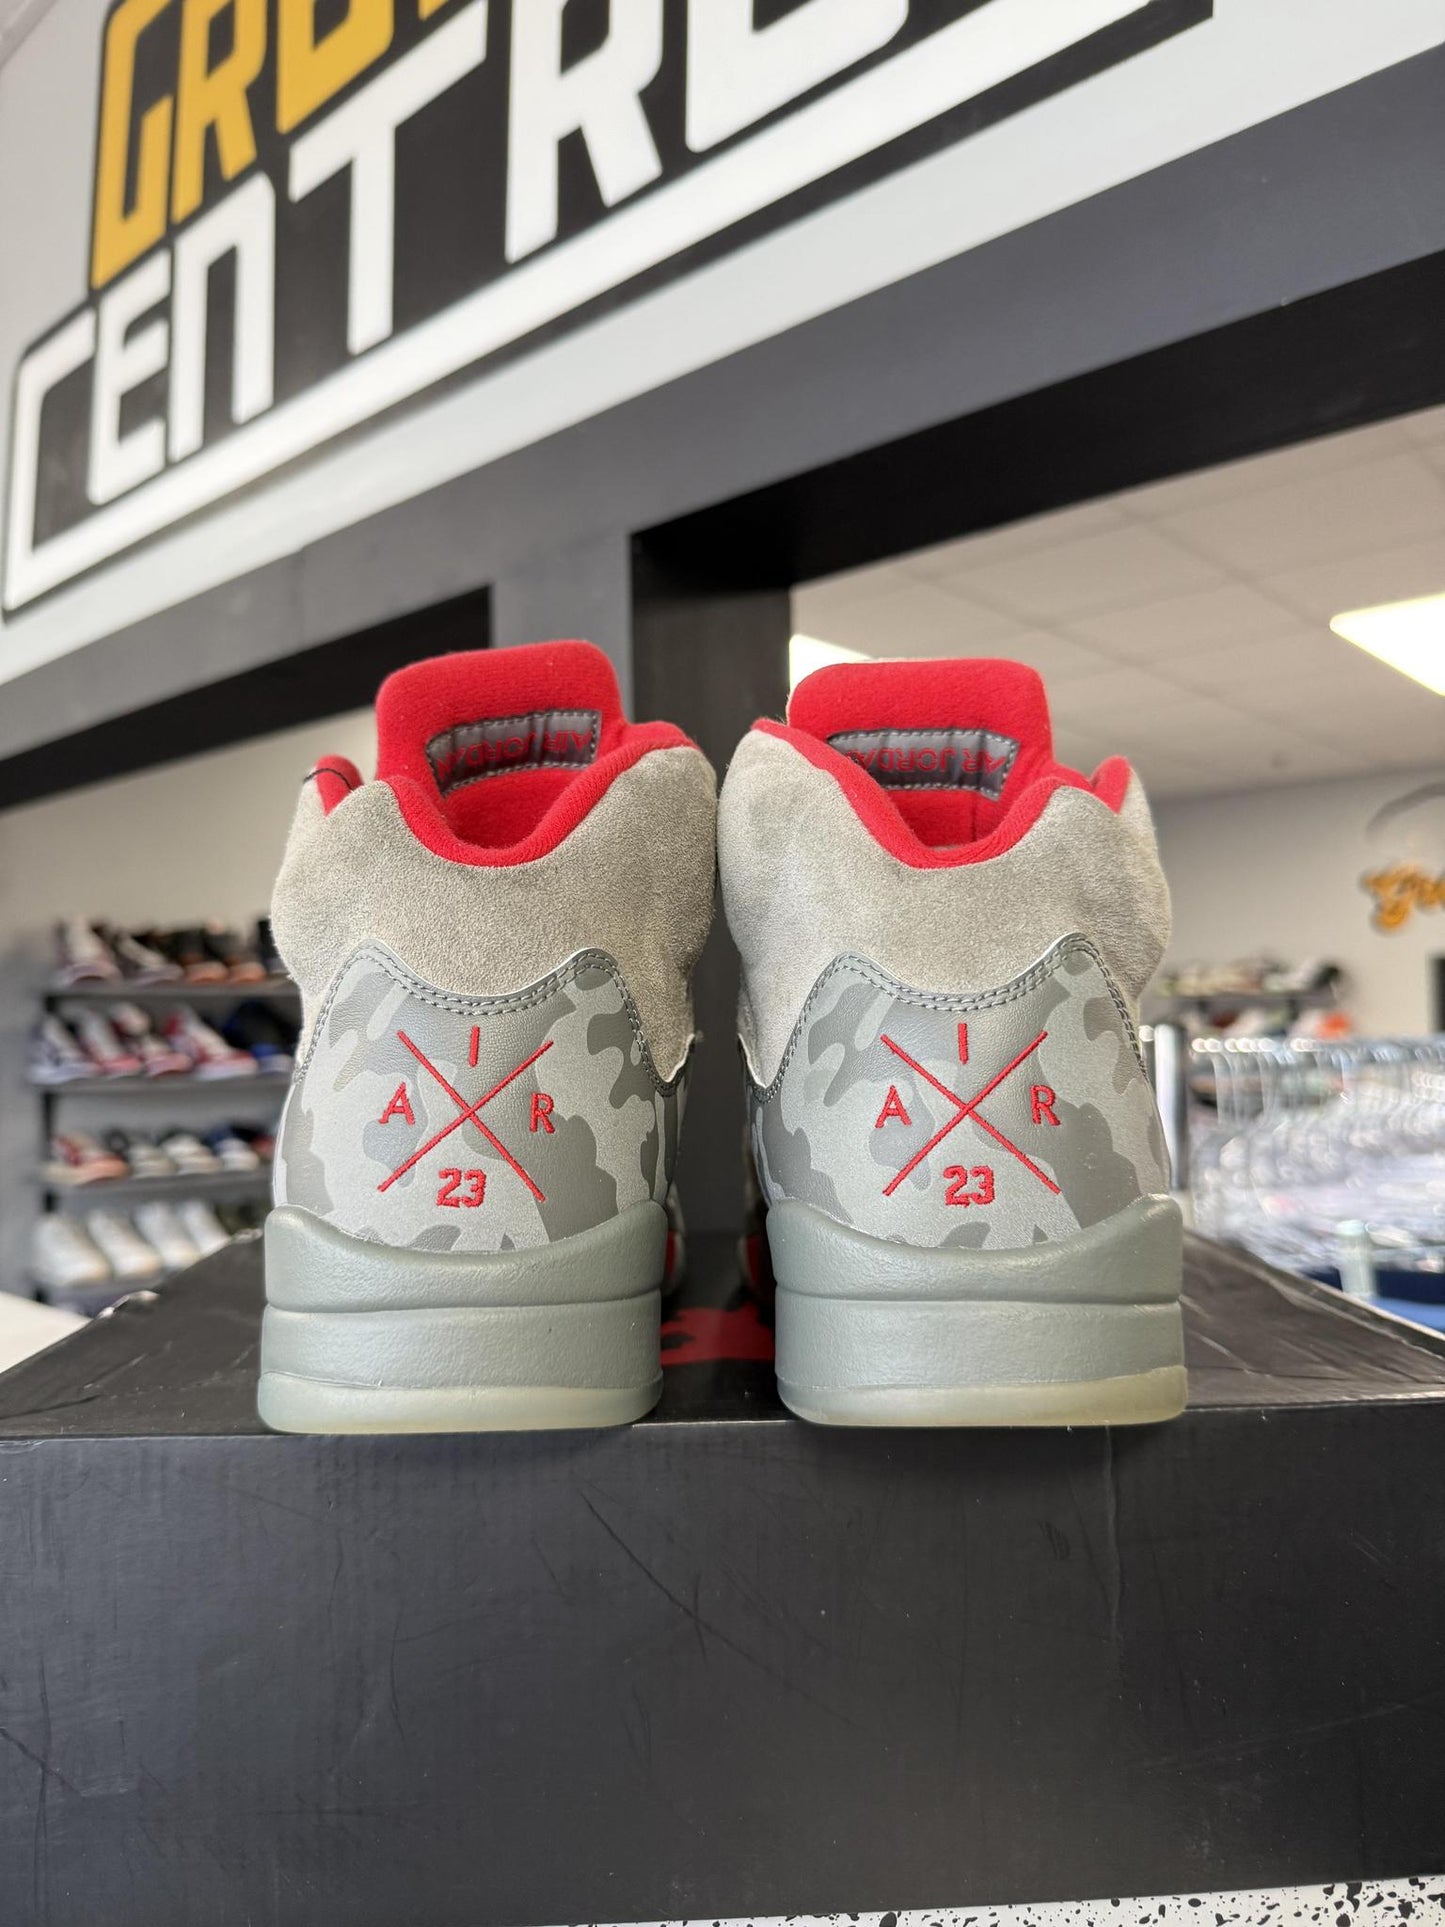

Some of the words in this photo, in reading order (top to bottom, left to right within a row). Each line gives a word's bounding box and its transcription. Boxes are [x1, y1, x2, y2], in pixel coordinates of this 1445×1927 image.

[436, 733, 538, 782] JORDAN
[846, 747, 957, 773] JORDA
[435, 1167, 487, 1208] 23
[943, 1165, 996, 1208] 23
